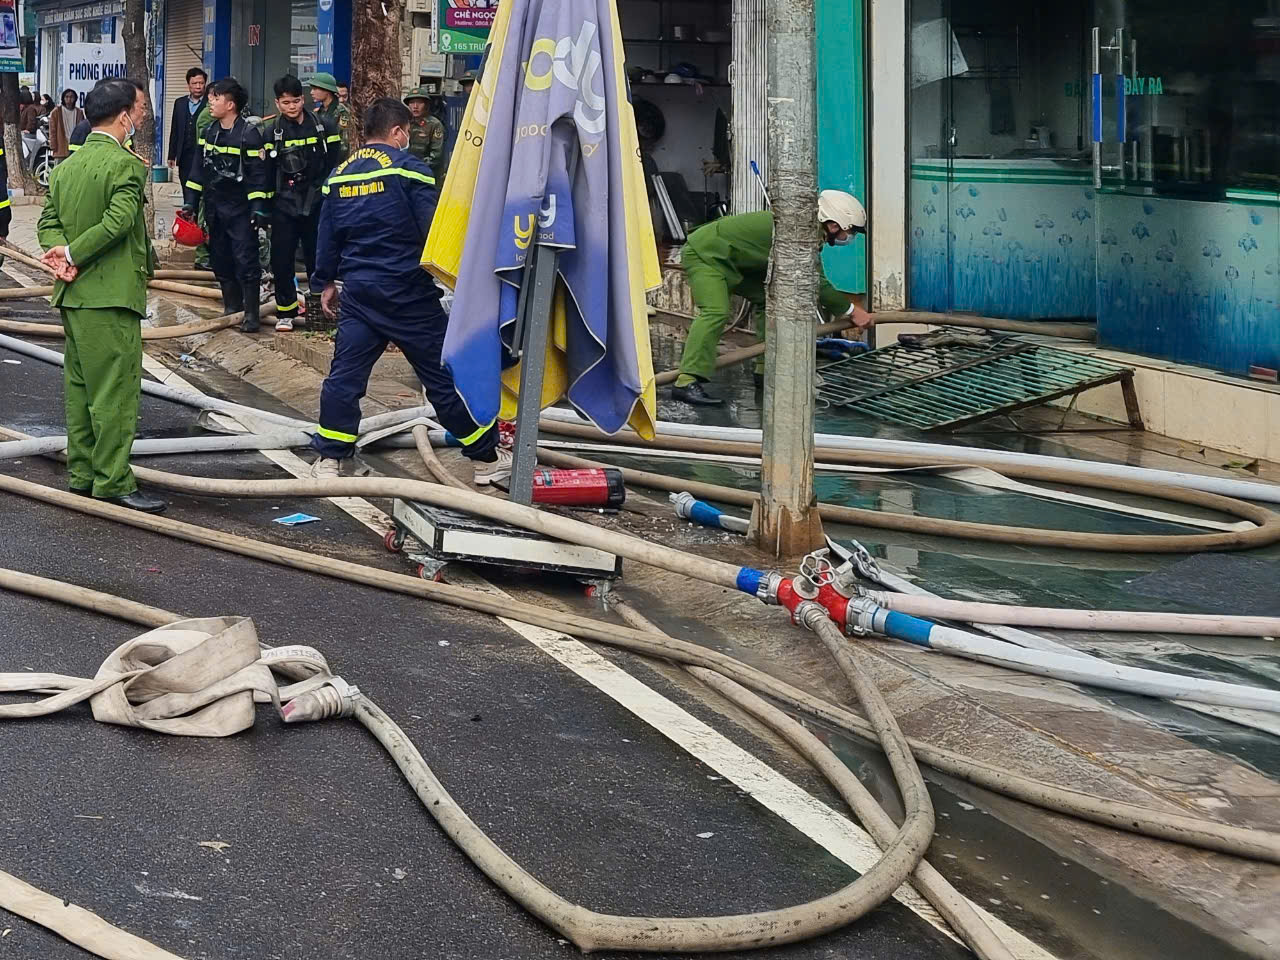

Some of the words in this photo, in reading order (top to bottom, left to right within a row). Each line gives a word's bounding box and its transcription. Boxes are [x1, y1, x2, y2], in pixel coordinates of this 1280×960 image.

[454, 9, 470, 18] CHÈ
[472, 11, 496, 20] NGỌC
[468, 43, 485, 51] TRƯ
[70, 59, 99, 80] PHÒNG
[102, 59, 128, 80] KHÁM
[1149, 77, 1163, 95] RA
[377, 181, 385, 192] LA
